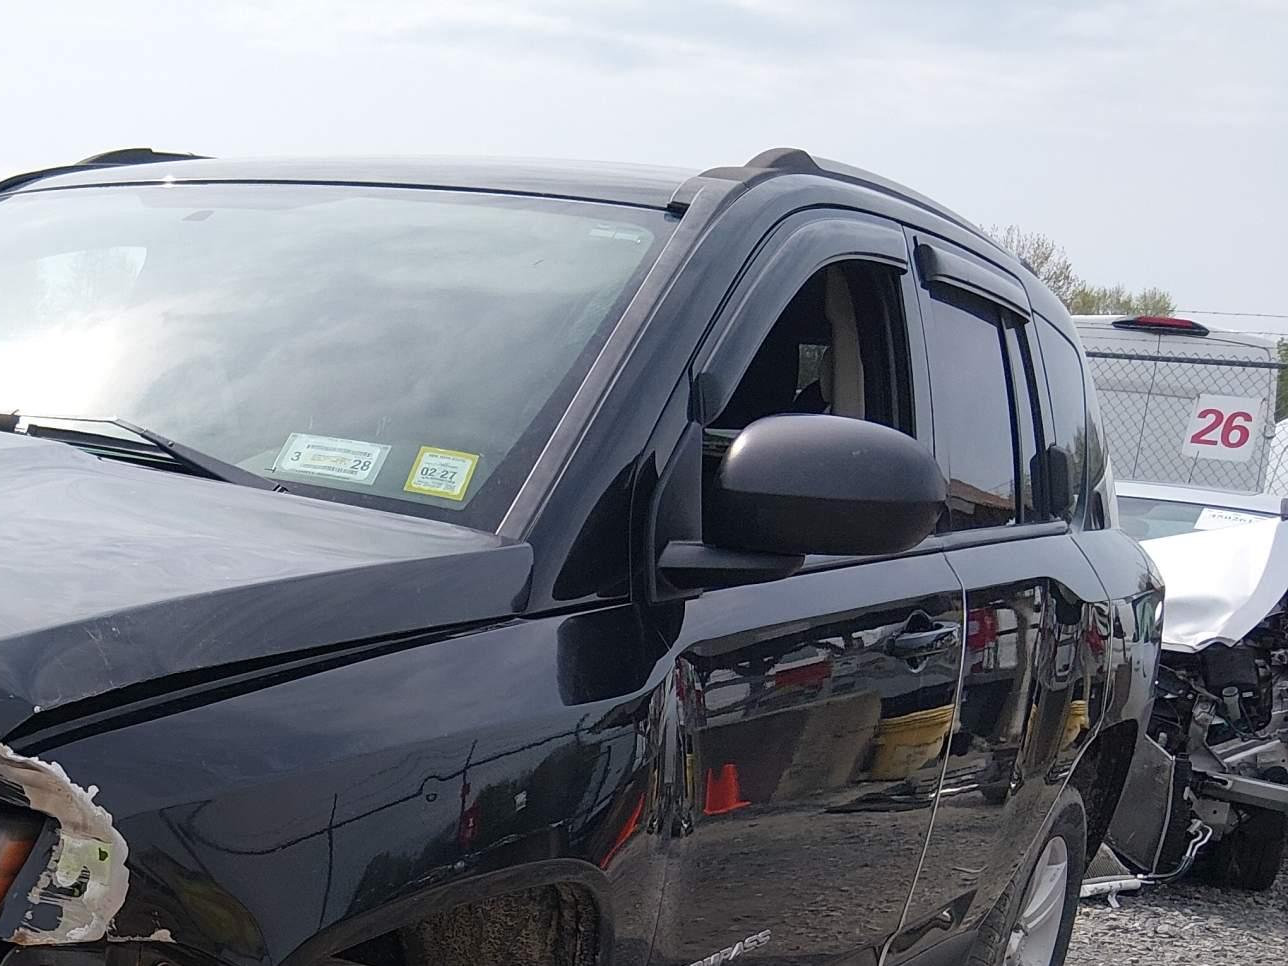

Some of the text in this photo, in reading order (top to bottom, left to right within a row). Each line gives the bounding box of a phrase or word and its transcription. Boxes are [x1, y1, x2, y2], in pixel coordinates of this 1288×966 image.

[1190, 408, 1253, 448] 26
[290, 451, 302, 462] 3
[350, 459, 372, 472] 28
[420, 466, 437, 477] 02
[439, 470, 458, 480] 27
